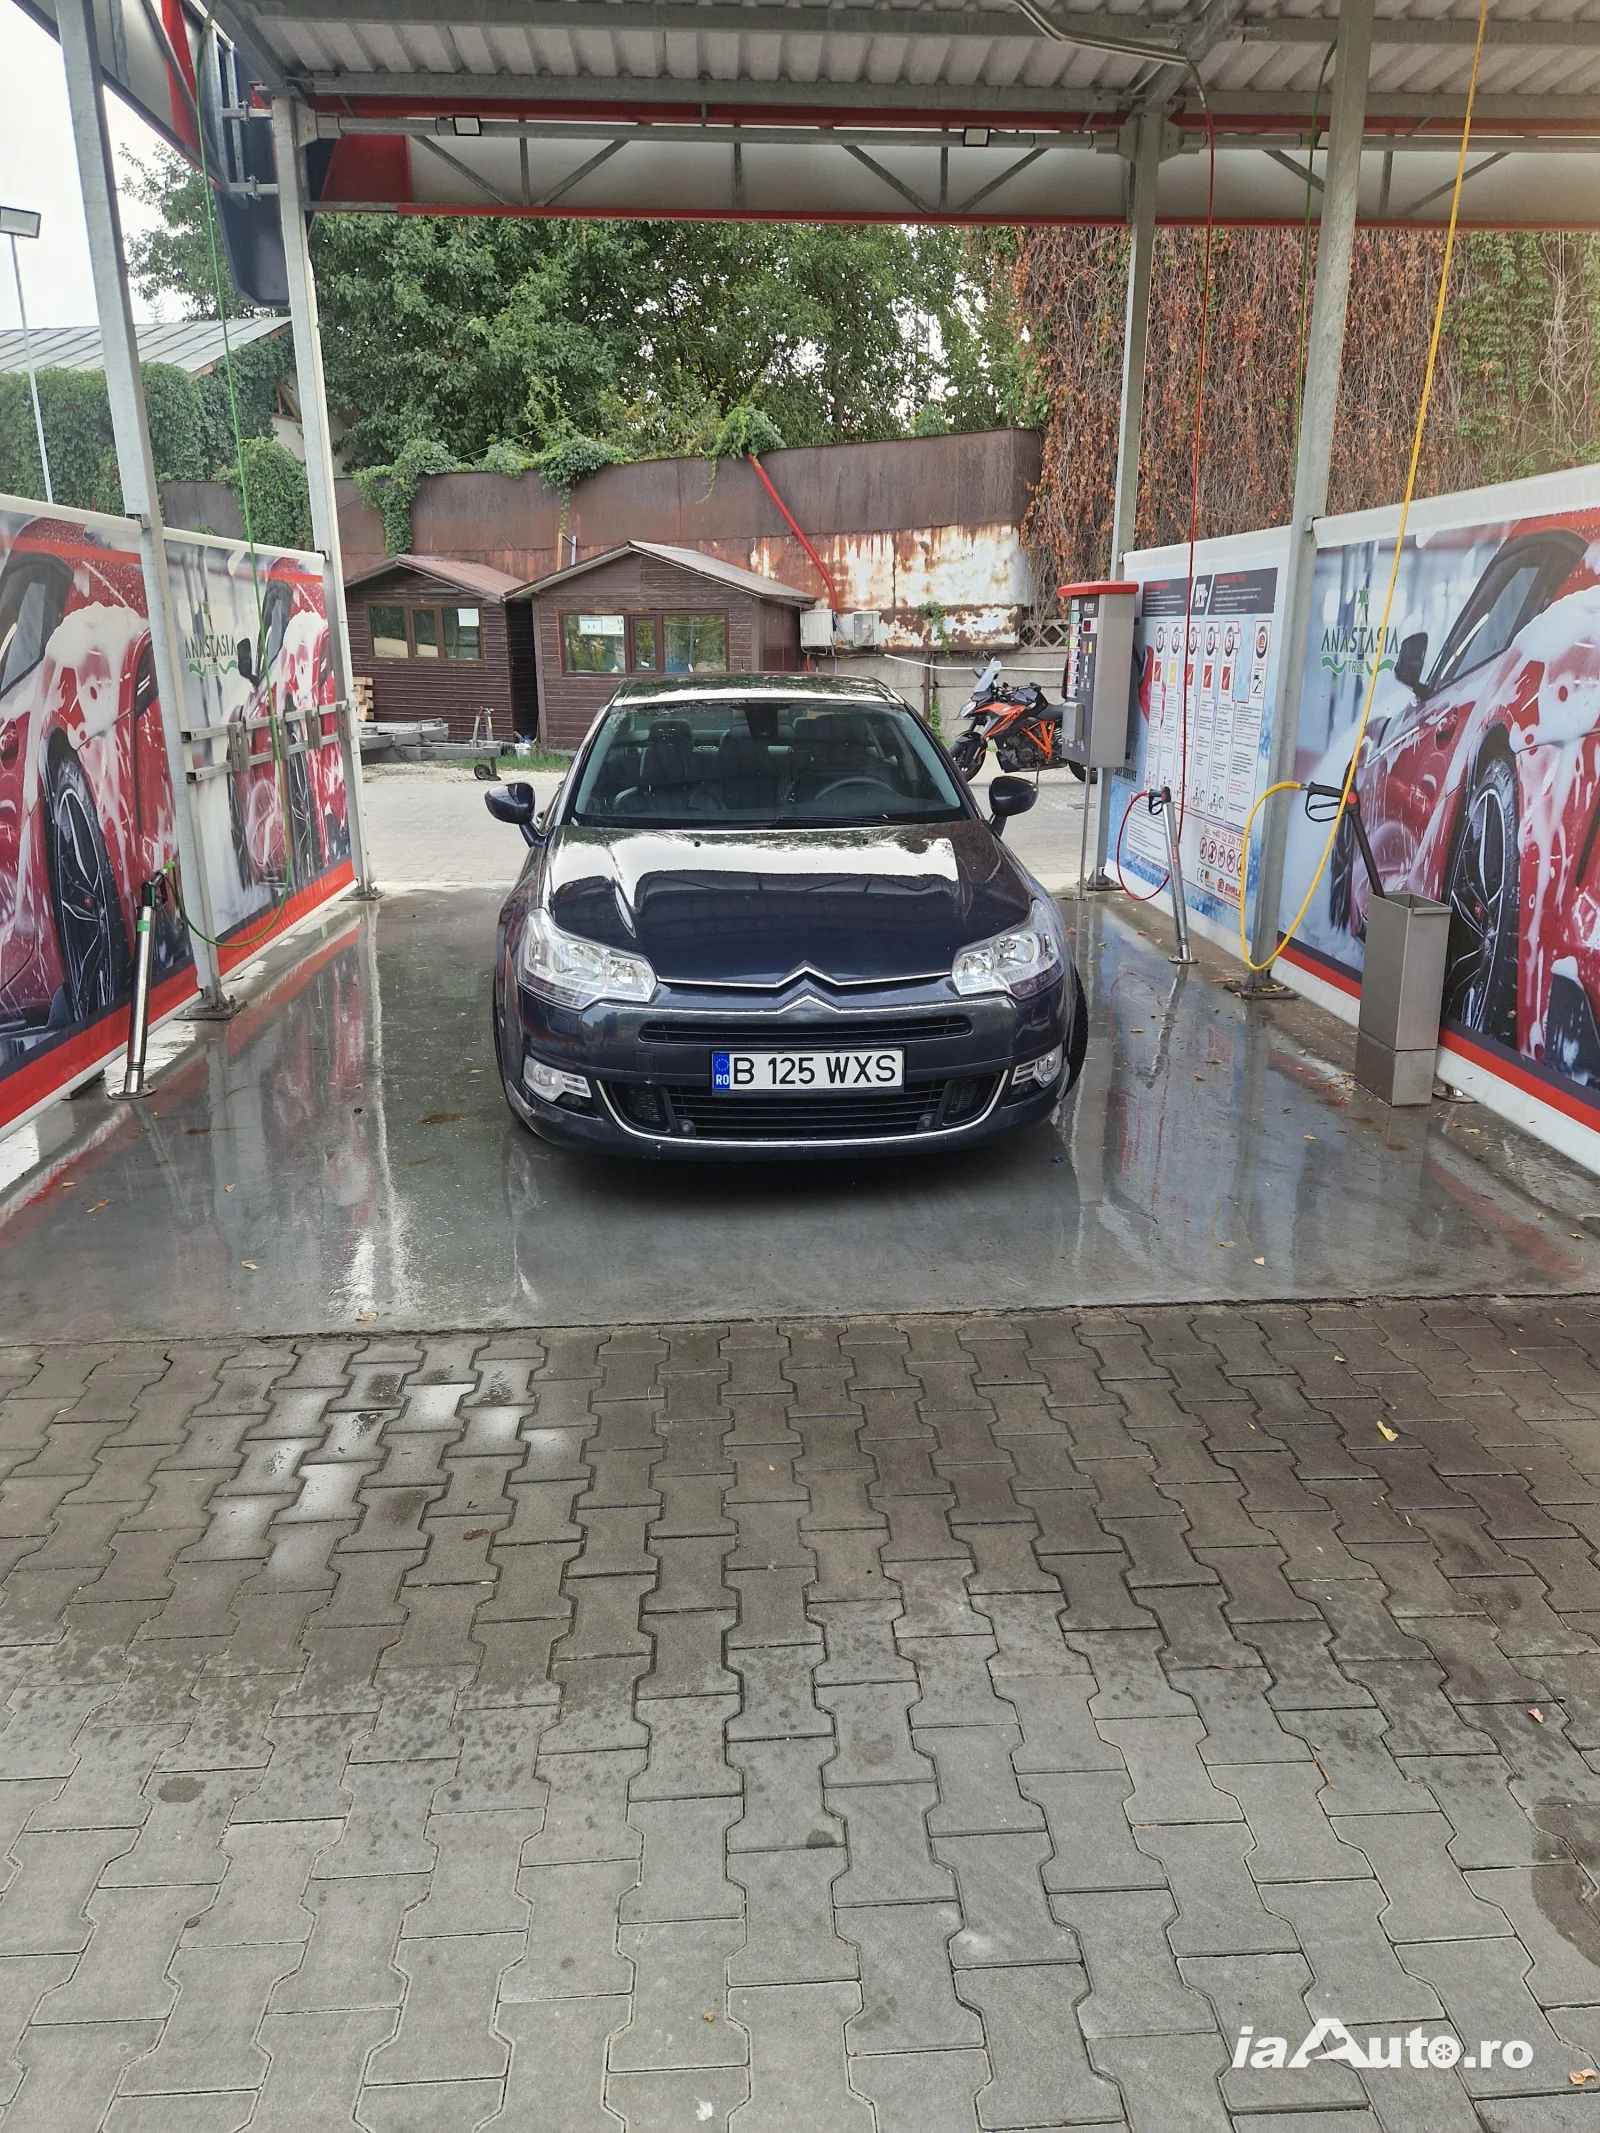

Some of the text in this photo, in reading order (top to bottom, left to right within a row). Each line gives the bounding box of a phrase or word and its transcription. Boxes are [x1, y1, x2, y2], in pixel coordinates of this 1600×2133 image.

[184, 634, 238, 659] ANASTASIA
[1321, 626, 1398, 654] ANASTASIA
[1348, 660, 1364, 674] TREE
[716, 1074, 730, 1086] RO
[733, 1054, 896, 1085] B 125 WXS
